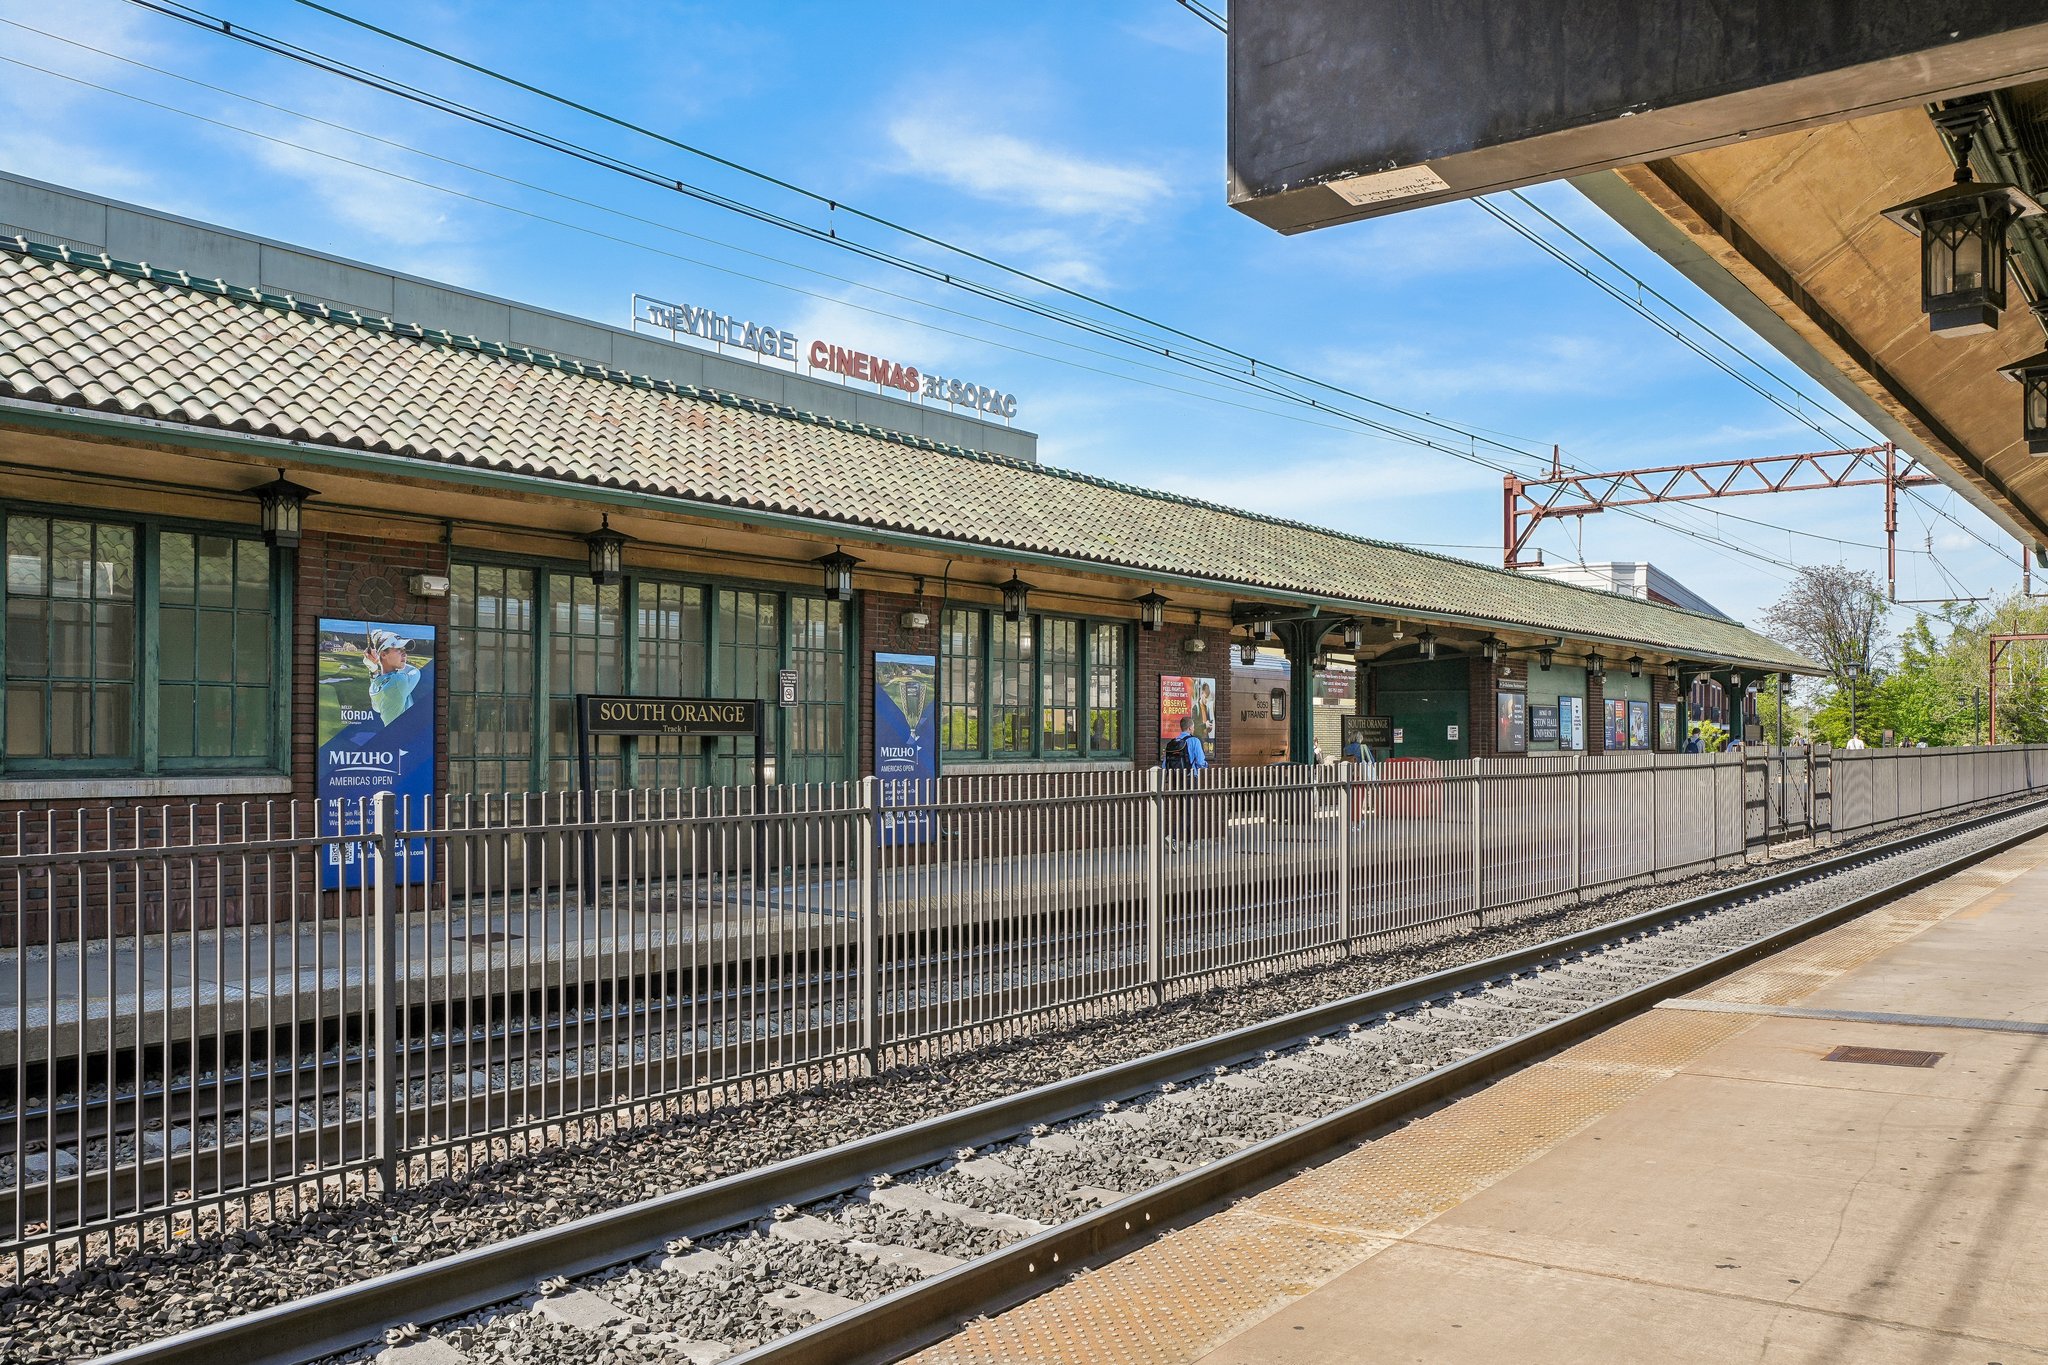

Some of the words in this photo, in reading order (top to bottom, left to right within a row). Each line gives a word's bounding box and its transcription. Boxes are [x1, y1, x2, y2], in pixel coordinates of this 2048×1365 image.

[647, 306, 684, 332] THE
[680, 303, 798, 361] VILLAGE
[808, 340, 920, 393] CINEMAS
[950, 378, 1018, 419] SOPAC
[1163, 699, 1186, 707] OBSERVE
[341, 710, 374, 721] KORDA
[600, 702, 665, 721] SOUTH
[671, 705, 745, 723] ORANGE
[1348, 719, 1366, 729] SOUTH
[1367, 719, 1388, 729] ORANGE
[1533, 718, 1546, 727] SETON
[1547, 718, 1557, 727] HALL
[662, 724, 681, 733] Track
[683, 725, 687, 733] 1
[1533, 729, 1557, 738] UNIVERSITY
[881, 746, 914, 758] MIZUHO
[329, 750, 394, 765] MIZUHO
[881, 765, 903, 773] AMERICAS
[903, 764, 915, 772] OPEN
[329, 776, 371, 787] AMERICAS
[372, 776, 393, 786] OPEN
